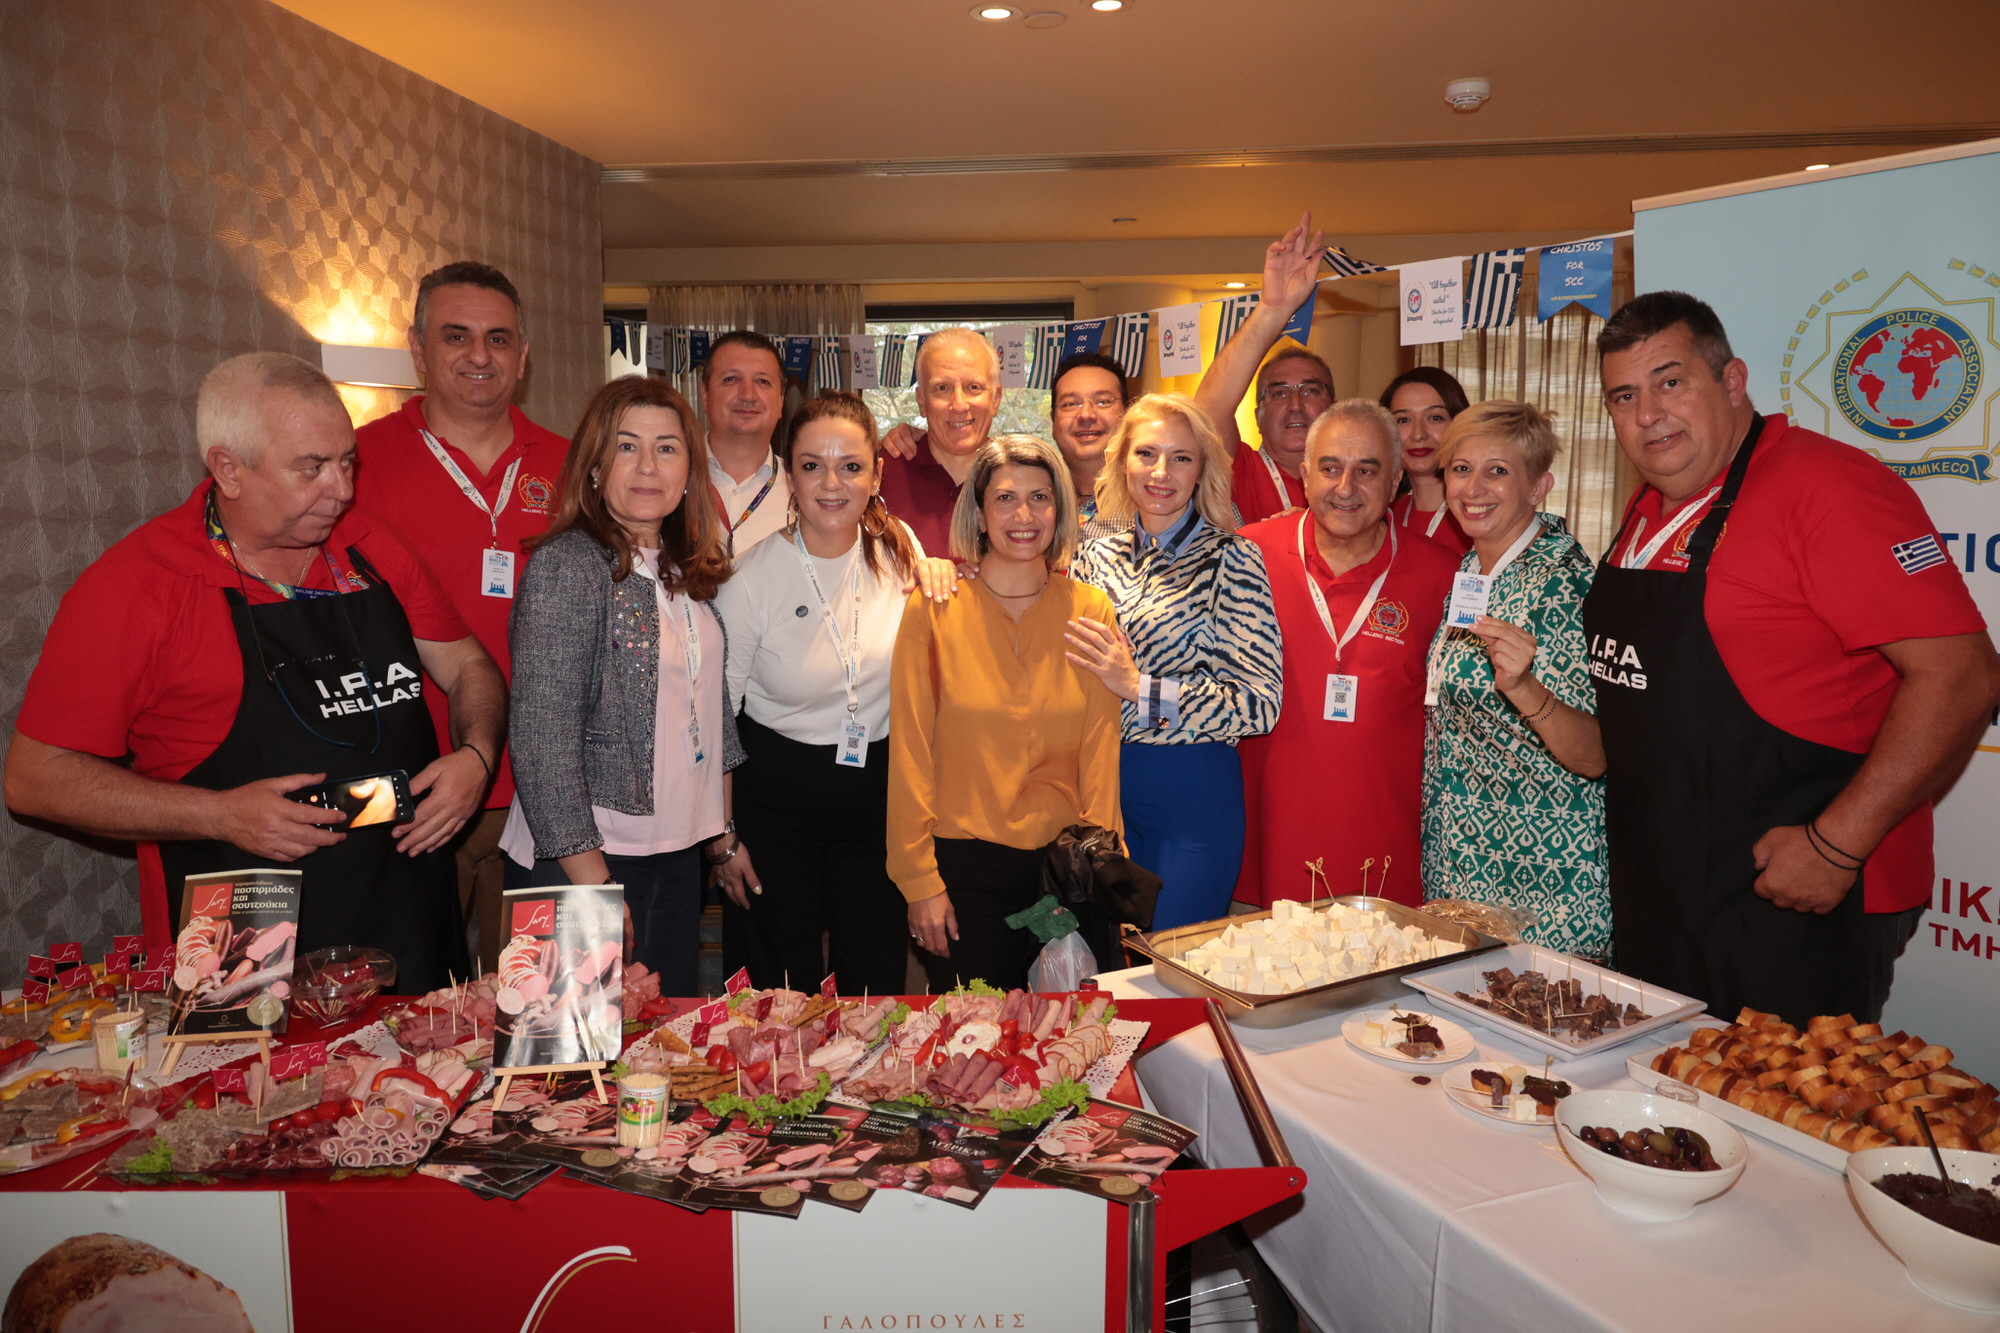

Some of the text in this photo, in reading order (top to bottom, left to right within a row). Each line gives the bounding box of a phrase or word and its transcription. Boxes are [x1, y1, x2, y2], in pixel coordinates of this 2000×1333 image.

[1550, 241, 1604, 255] CHRISTOS
[1565, 261, 1585, 270] FOR
[1564, 276, 1585, 287] SCC
[1886, 311, 1940, 326] POLICE
[1834, 334, 1866, 427] INTERNATIONAL
[1942, 337, 1980, 424] ASSOCIATION
[1909, 461, 1971, 477] AMIKECO
[1591, 634, 1643, 670] I.P.A
[315, 661, 418, 699] I.P.A
[1588, 658, 1648, 690] HELLAS
[319, 682, 421, 719] HELLAS
[231, 900, 288, 910] σουτζούκια
[232, 894, 248, 902] και
[822, 1313, 1026, 1330] ΓΑΛΟΠΟΥΛΕΣ
